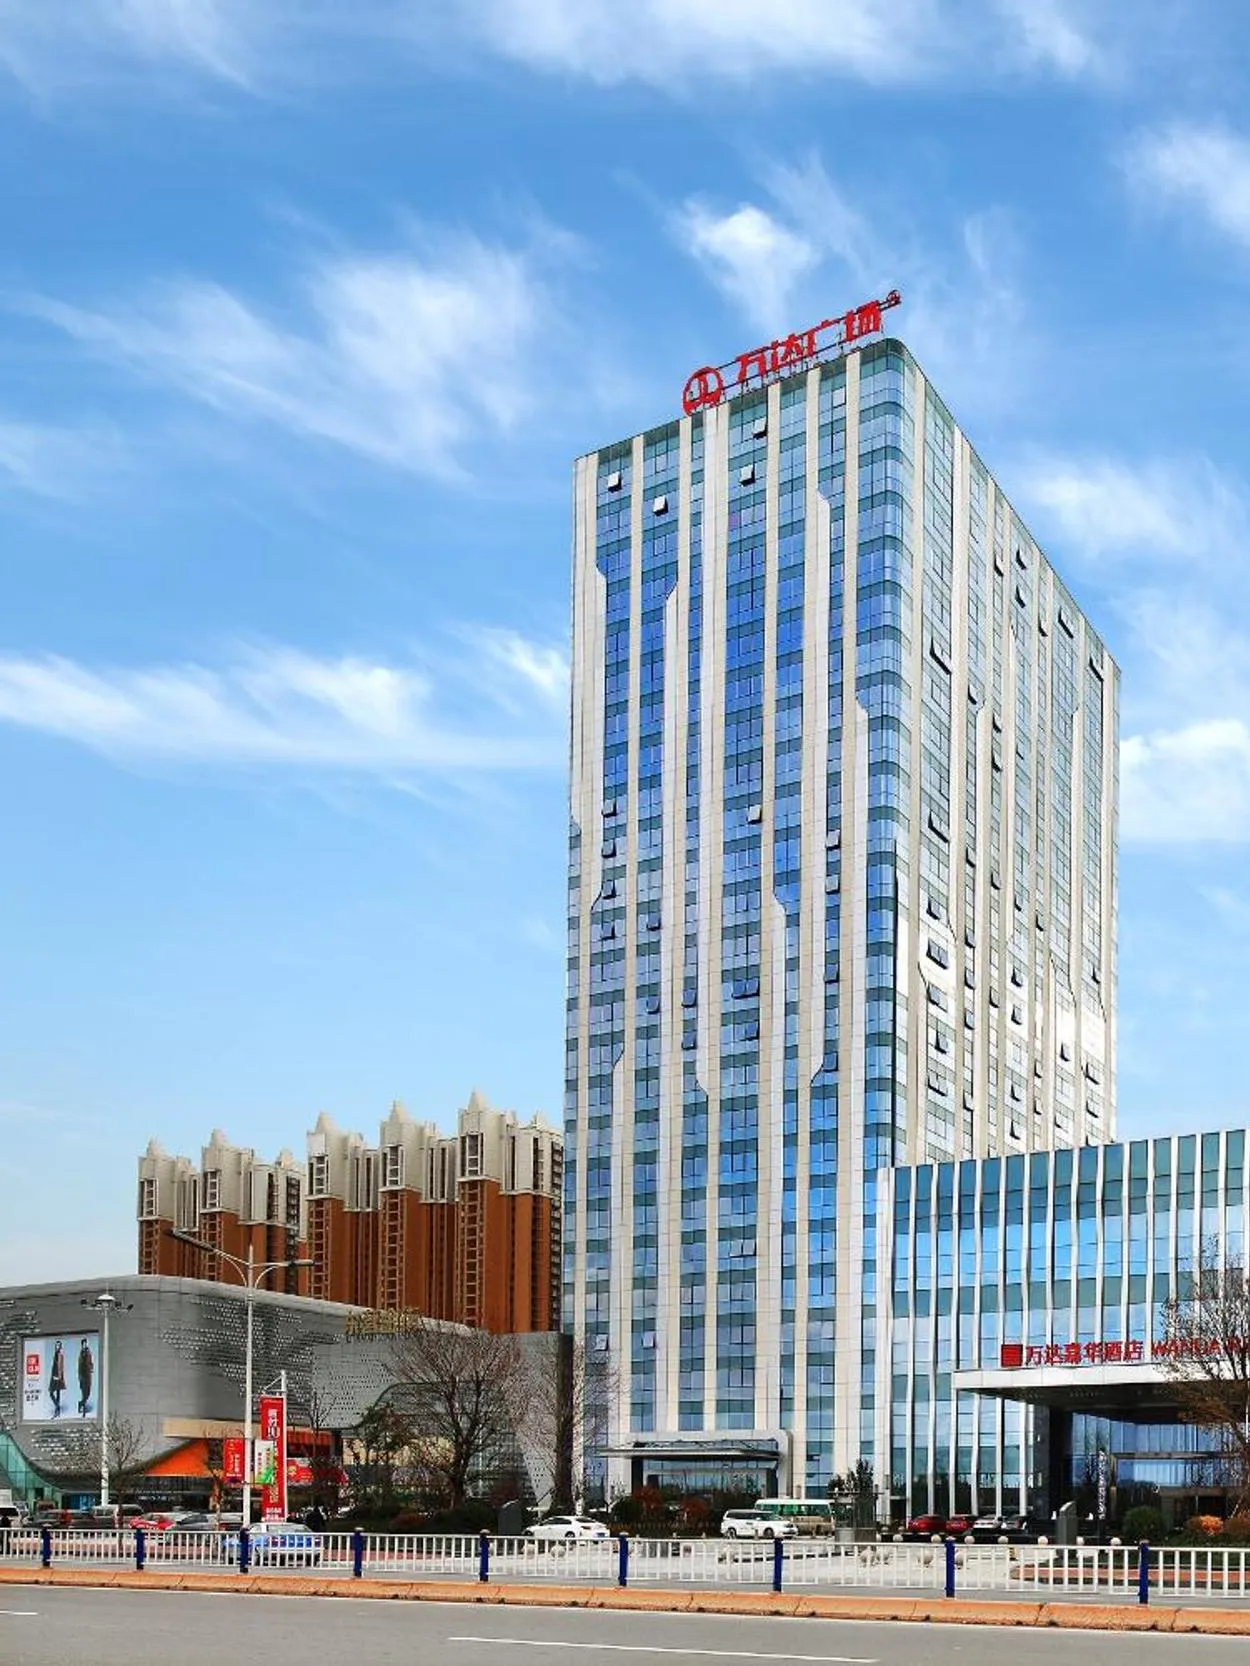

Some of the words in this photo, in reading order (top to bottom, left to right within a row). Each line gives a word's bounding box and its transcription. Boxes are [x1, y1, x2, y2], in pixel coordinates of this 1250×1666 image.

[735, 299, 882, 384] 万达广场
[1025, 1340, 1144, 1366] 万达嘉华酒店
